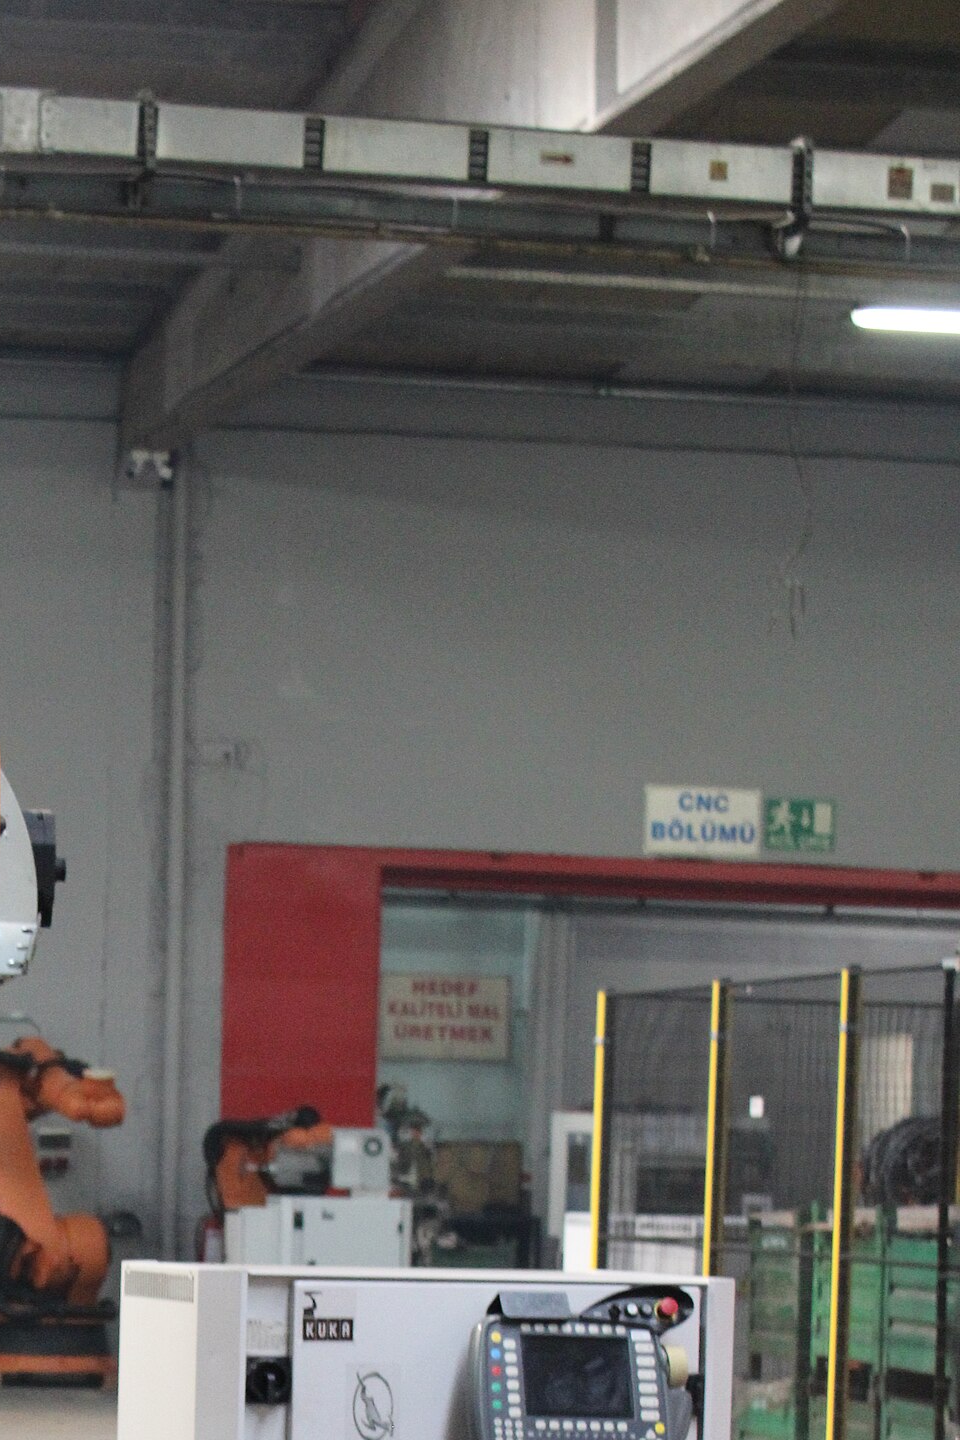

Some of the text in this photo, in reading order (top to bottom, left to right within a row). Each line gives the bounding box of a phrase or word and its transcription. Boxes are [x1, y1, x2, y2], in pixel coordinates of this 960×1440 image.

[678, 791, 730, 813] CNC
[650, 818, 756, 844] BÖLÜMÜ
[411, 980, 479, 997] HEDEF
[303, 1319, 352, 1340] KUKA
